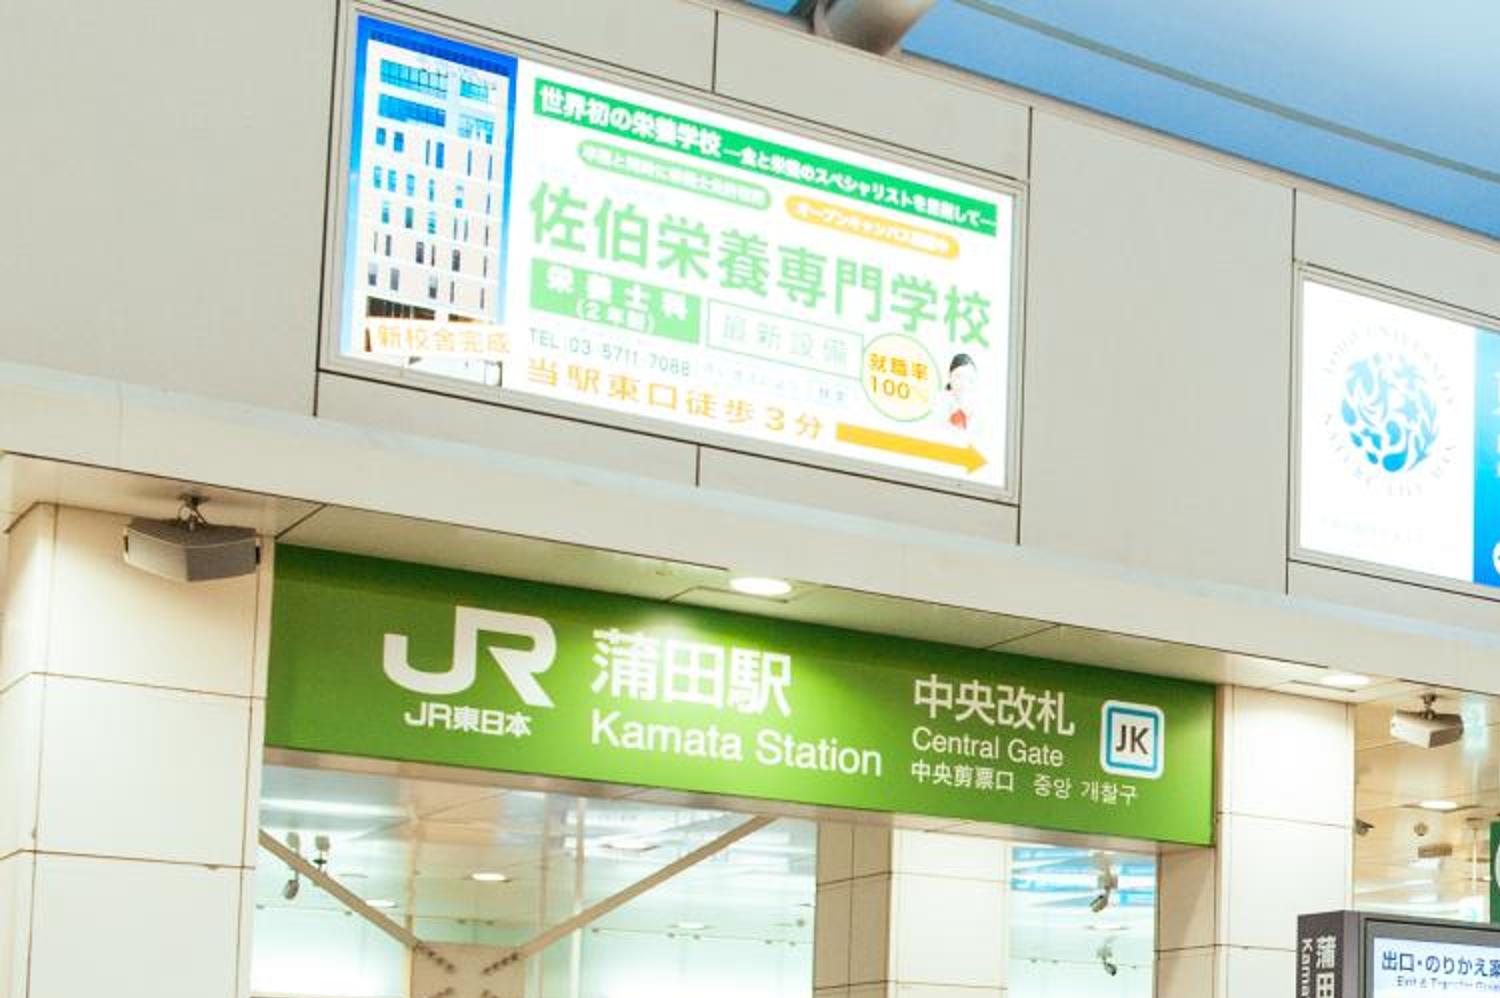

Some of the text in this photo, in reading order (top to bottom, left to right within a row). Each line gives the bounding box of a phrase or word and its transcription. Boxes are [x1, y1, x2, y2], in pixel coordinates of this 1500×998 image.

[528, 179, 994, 351] 佐伯栄養専門学校
[528, 357, 823, 440] 当駅東口徒歩3分
[383, 605, 558, 709] JR
[590, 627, 793, 718] 蒲田駅
[404, 702, 532, 738] JR東日本
[913, 673, 1075, 737] 中央改札
[592, 709, 884, 778] Kamata Station
[912, 726, 1064, 768] Central Gate
[1115, 724, 1152, 755] JK
[1033, 774, 1138, 805] 중앙 개찰구
